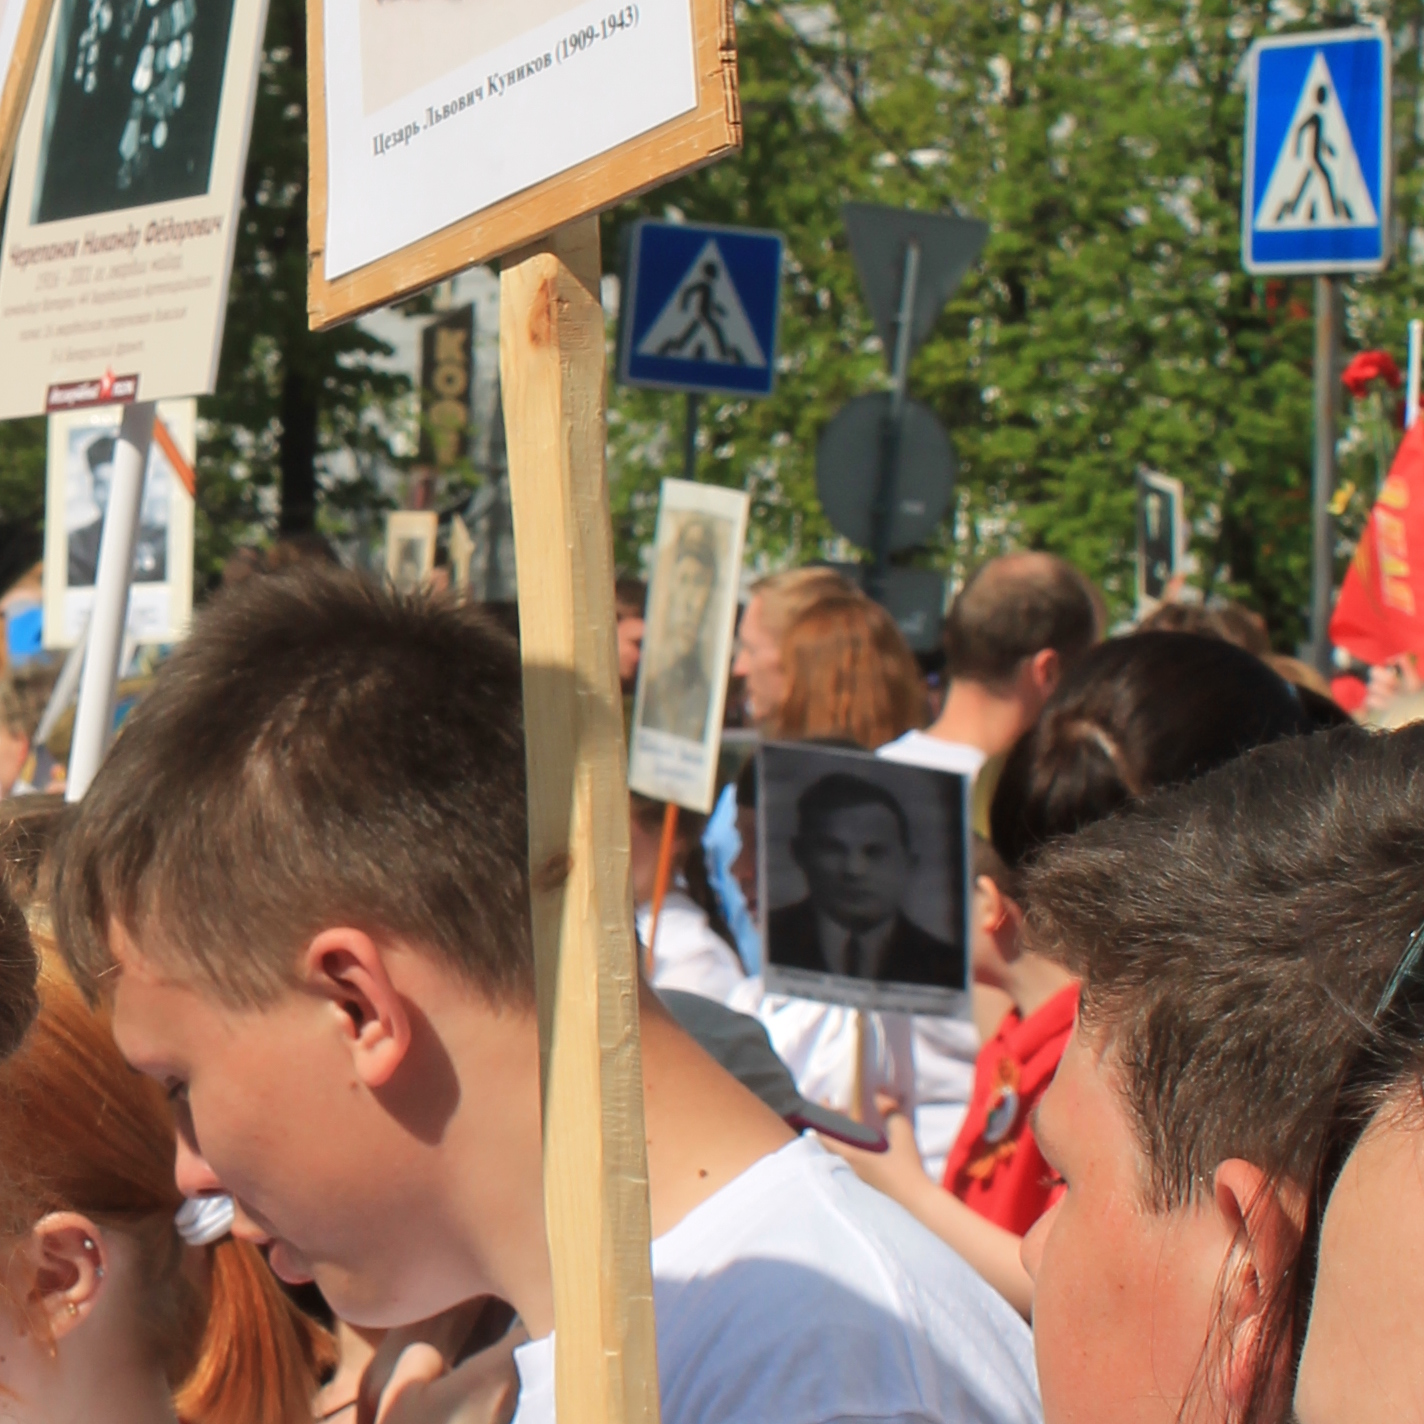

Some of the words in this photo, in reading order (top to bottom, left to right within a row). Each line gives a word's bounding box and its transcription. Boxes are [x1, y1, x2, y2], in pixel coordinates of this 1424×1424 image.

[372, 121, 420, 156] Цезарь
[423, 85, 484, 130] Львович
[486, 52, 553, 97] Куников
[554, 3, 640, 64] (1909-1943)
